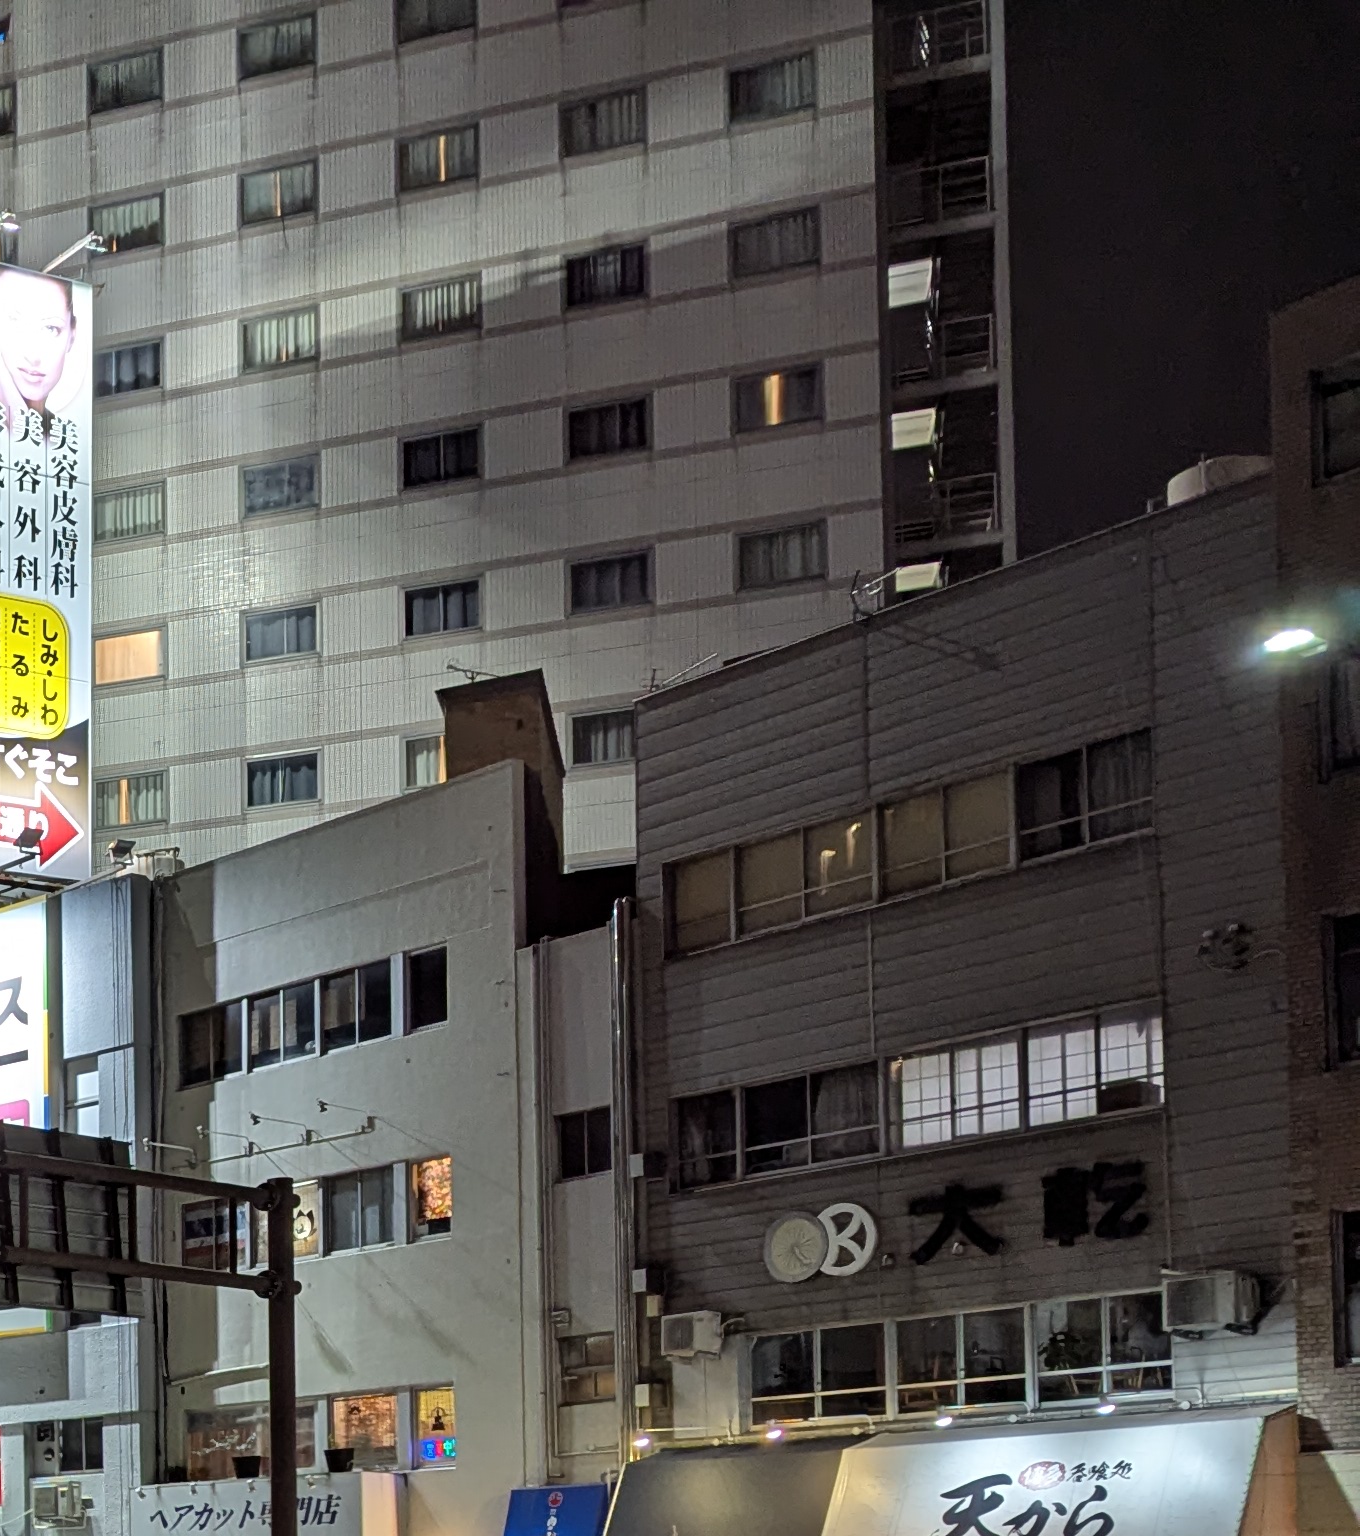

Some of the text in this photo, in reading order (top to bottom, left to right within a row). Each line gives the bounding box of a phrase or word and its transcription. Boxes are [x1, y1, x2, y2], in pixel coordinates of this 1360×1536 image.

[12, 408, 44, 592] 美容外科
[49, 416, 79, 598] 美容皮膚科
[10, 611, 30, 719] たるみ
[39, 617, 60, 727] しみ・しわ
